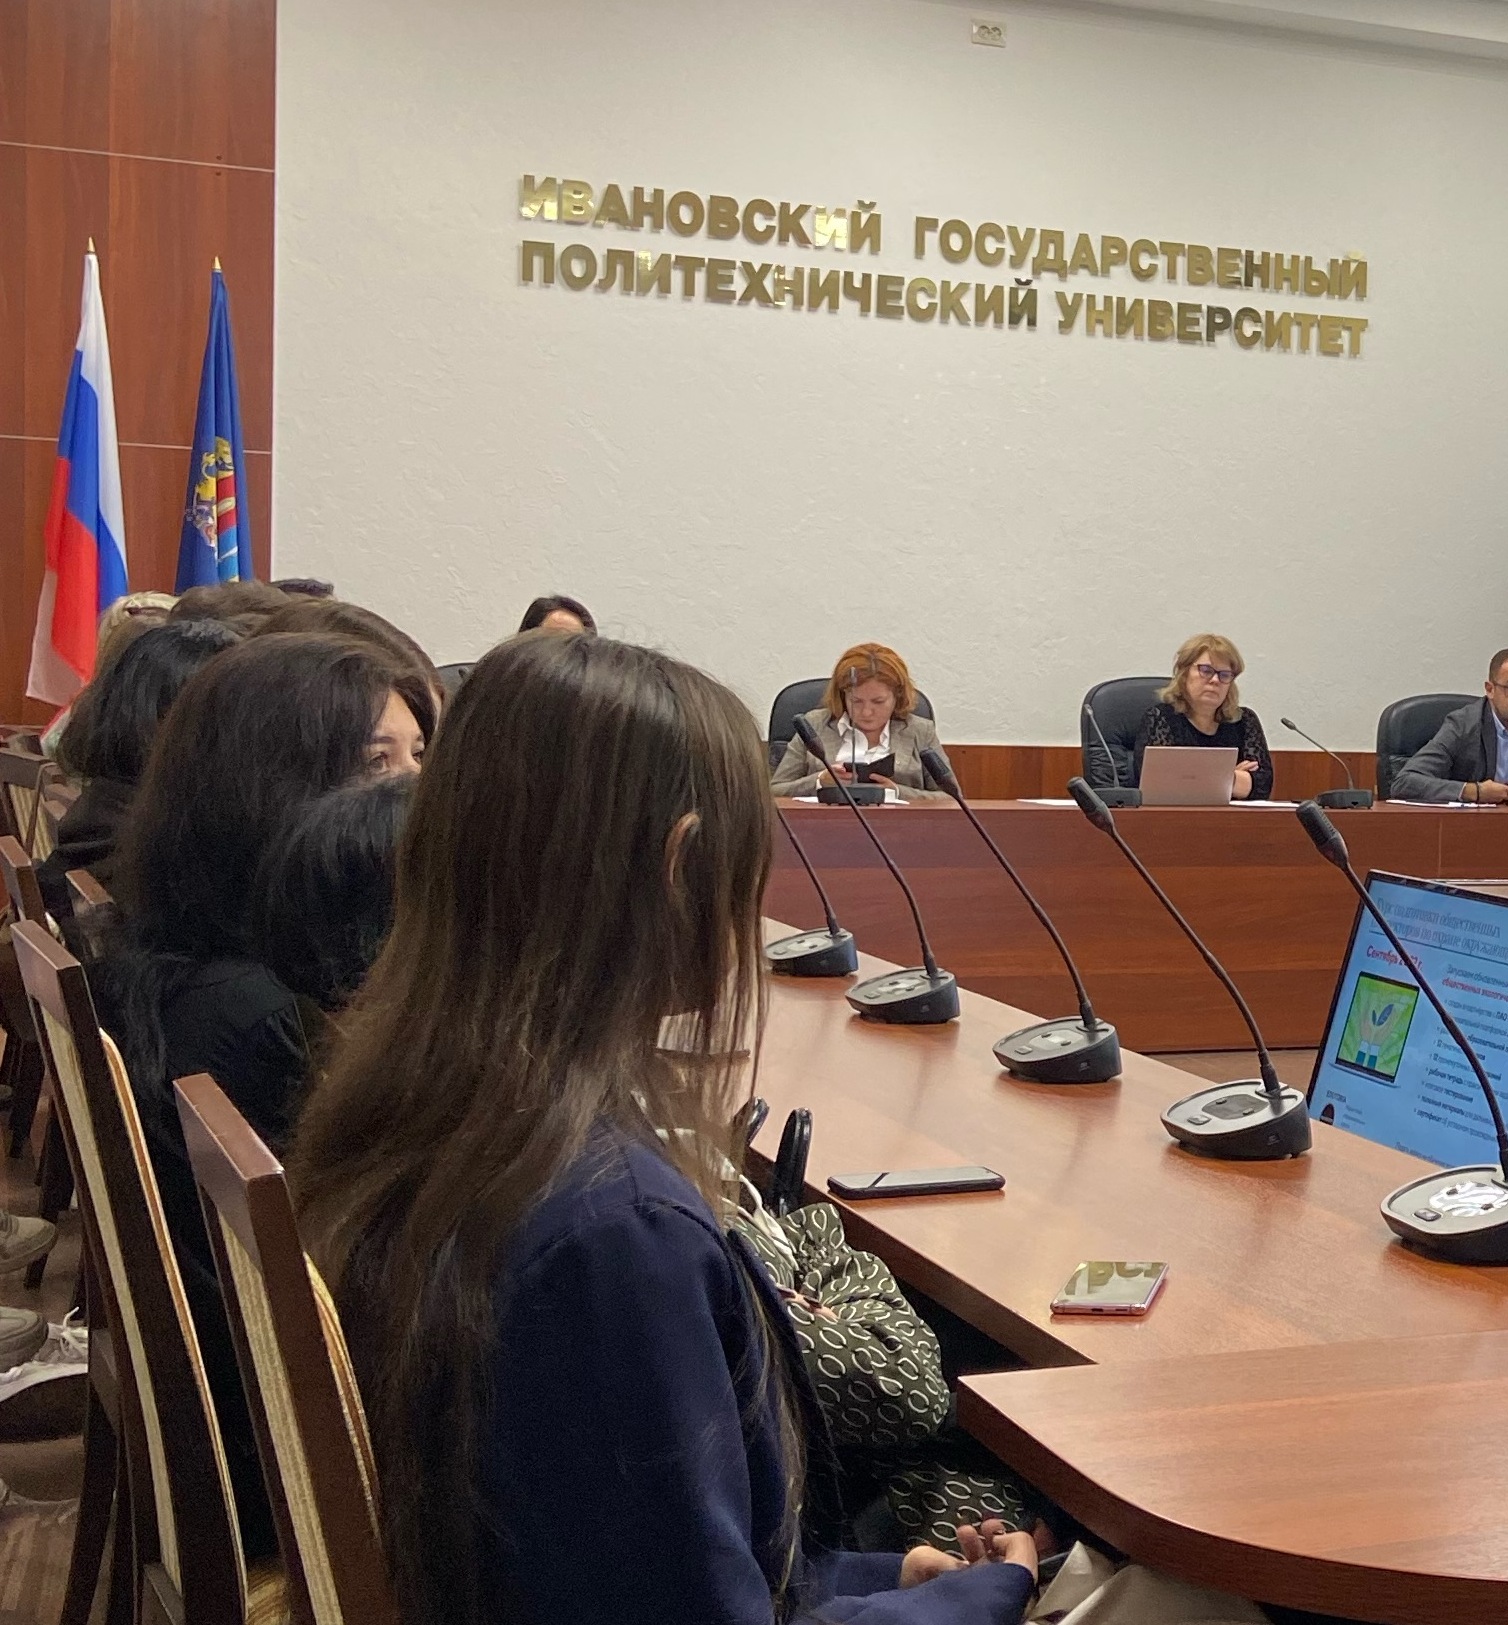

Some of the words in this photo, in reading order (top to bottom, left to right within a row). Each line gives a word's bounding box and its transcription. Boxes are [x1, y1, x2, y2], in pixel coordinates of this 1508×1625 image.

[520, 174, 882, 257] ИВАНОВСКИЙ
[914, 215, 1370, 300] ГОСУДАРСТВЕННЫЙ
[519, 240, 1039, 328] ПОЛИТЕХНИЧЕСКИЙ
[1055, 290, 1370, 357] УНИВЕРСИТЕТ
